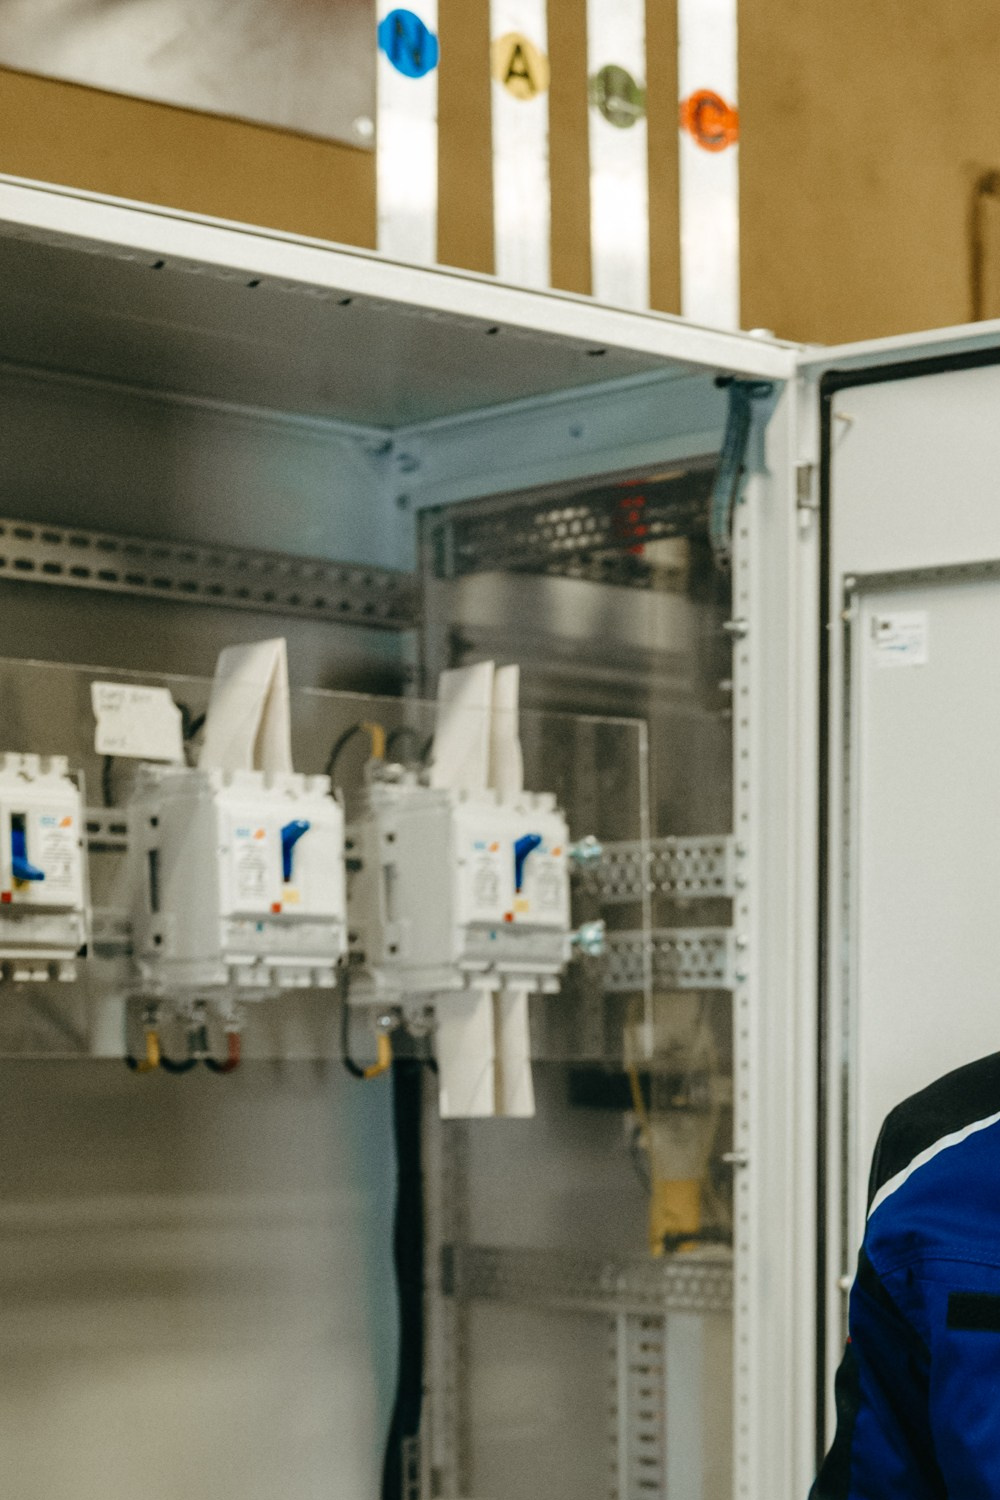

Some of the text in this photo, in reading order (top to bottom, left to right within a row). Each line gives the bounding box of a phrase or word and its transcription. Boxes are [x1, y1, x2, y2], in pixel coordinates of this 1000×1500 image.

[390, 13, 426, 71] N
[504, 44, 537, 94] A
[694, 97, 725, 144] C
